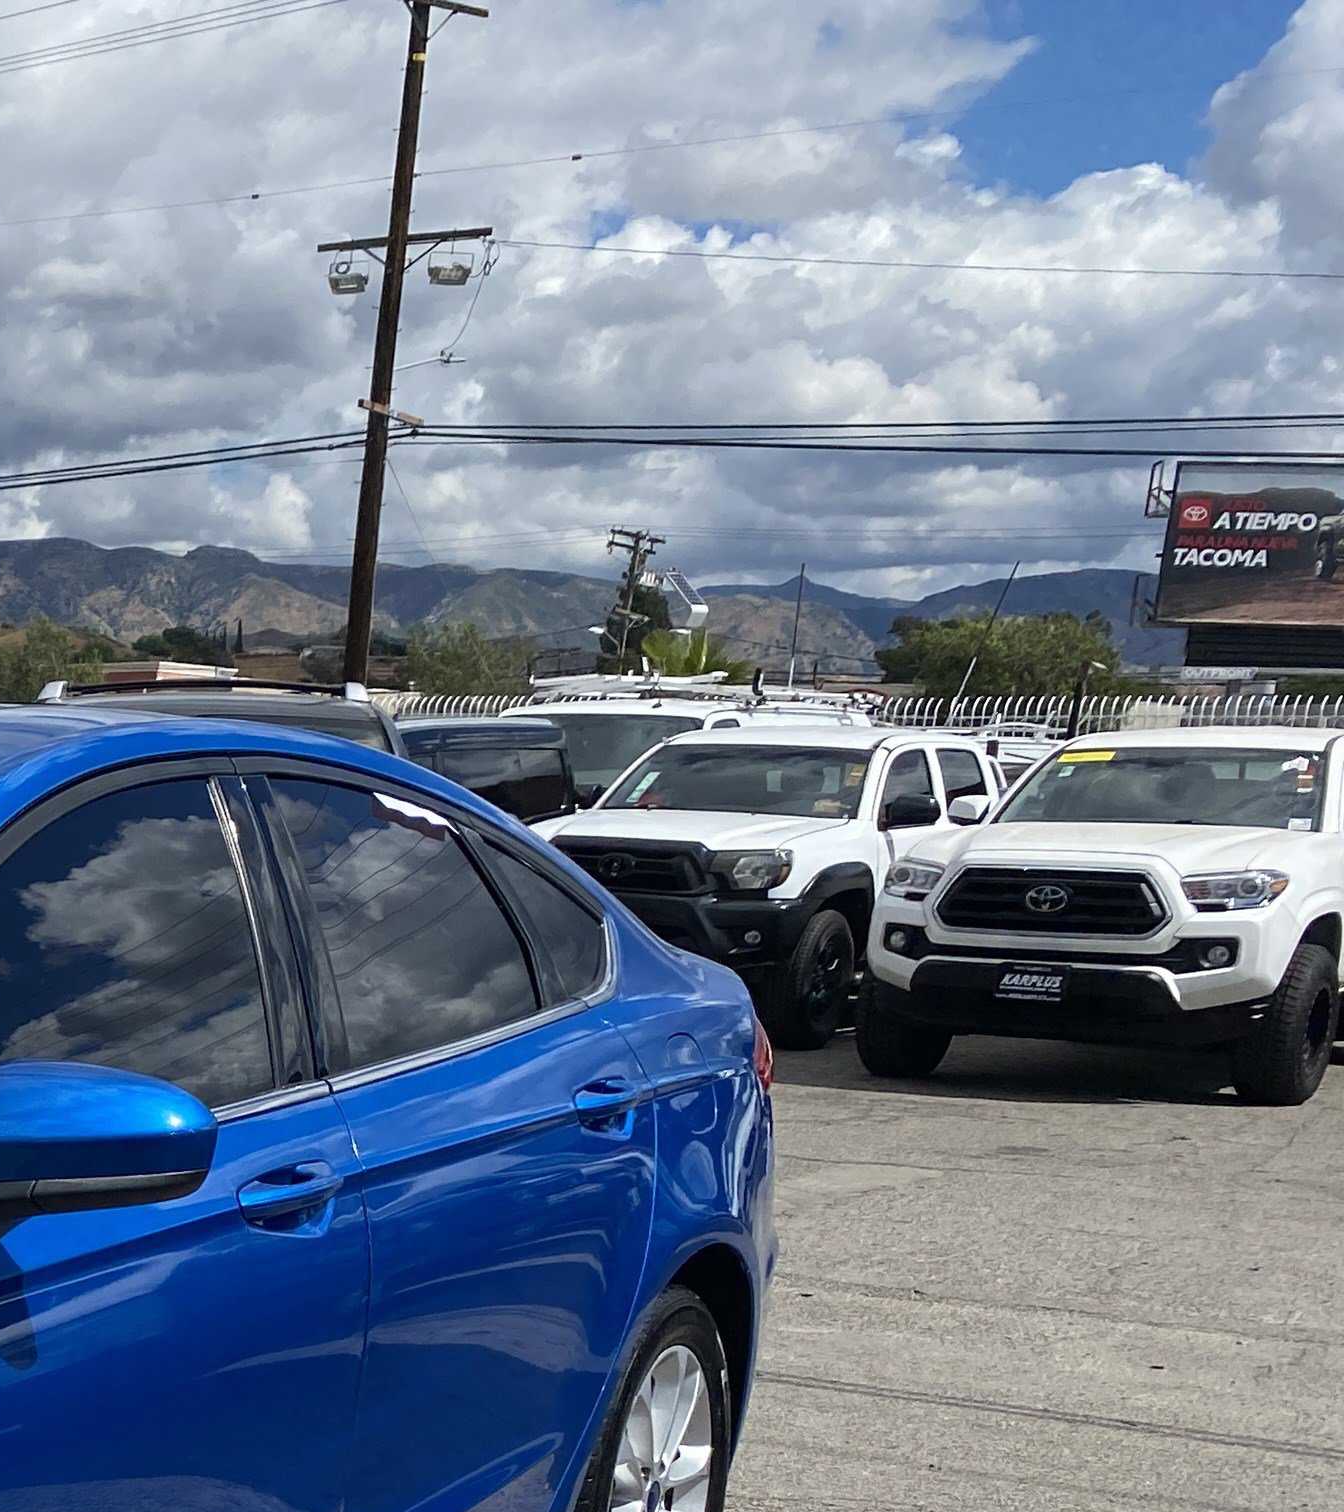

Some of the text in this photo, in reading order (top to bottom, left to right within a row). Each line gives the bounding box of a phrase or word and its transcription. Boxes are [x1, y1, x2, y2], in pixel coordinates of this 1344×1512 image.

[1213, 512, 1319, 532] A TIEMPO
[1173, 548, 1269, 567] TACOMA
[1000, 973, 1063, 988] KARPLUS
